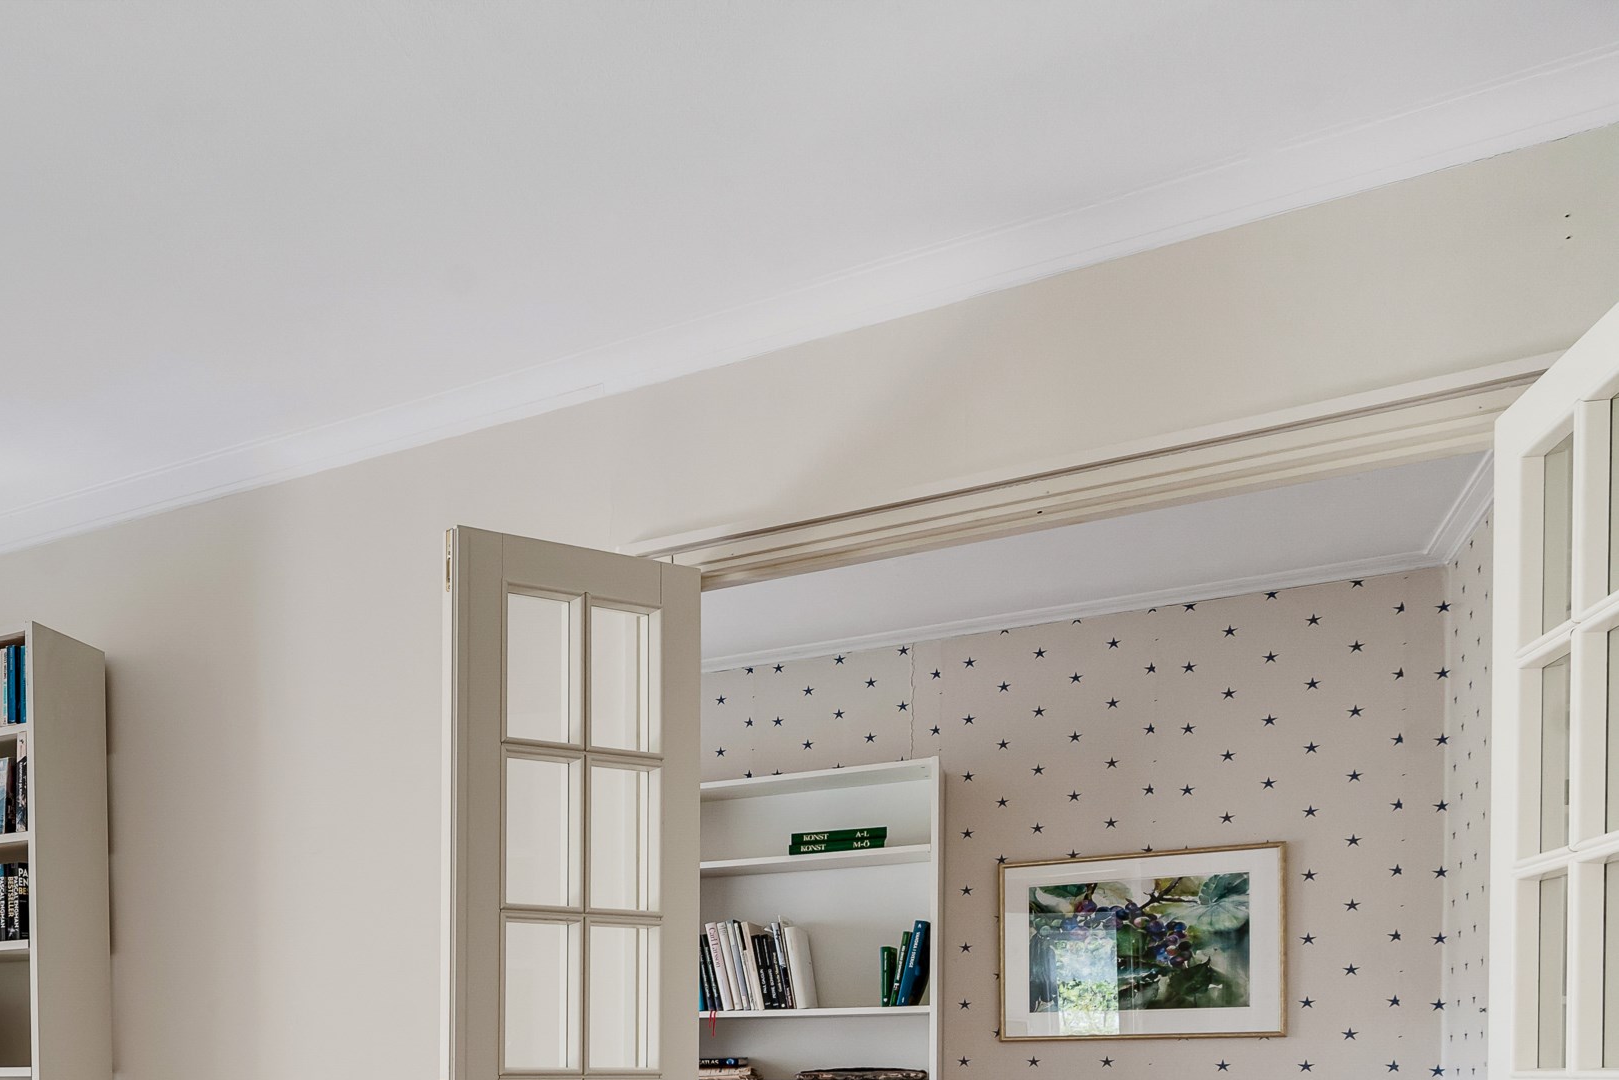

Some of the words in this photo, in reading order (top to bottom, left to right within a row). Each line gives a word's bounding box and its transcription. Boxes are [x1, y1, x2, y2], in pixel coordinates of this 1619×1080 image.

[803, 833, 829, 841] KONST
[800, 844, 827, 852] KONST
[852, 840, 870, 848] M-Ö
[7, 876, 15, 917] BESTSELLER
[709, 927, 719, 941] Carl
[711, 942, 721, 968] Larsson
[909, 951, 917, 968] SVERIGE
